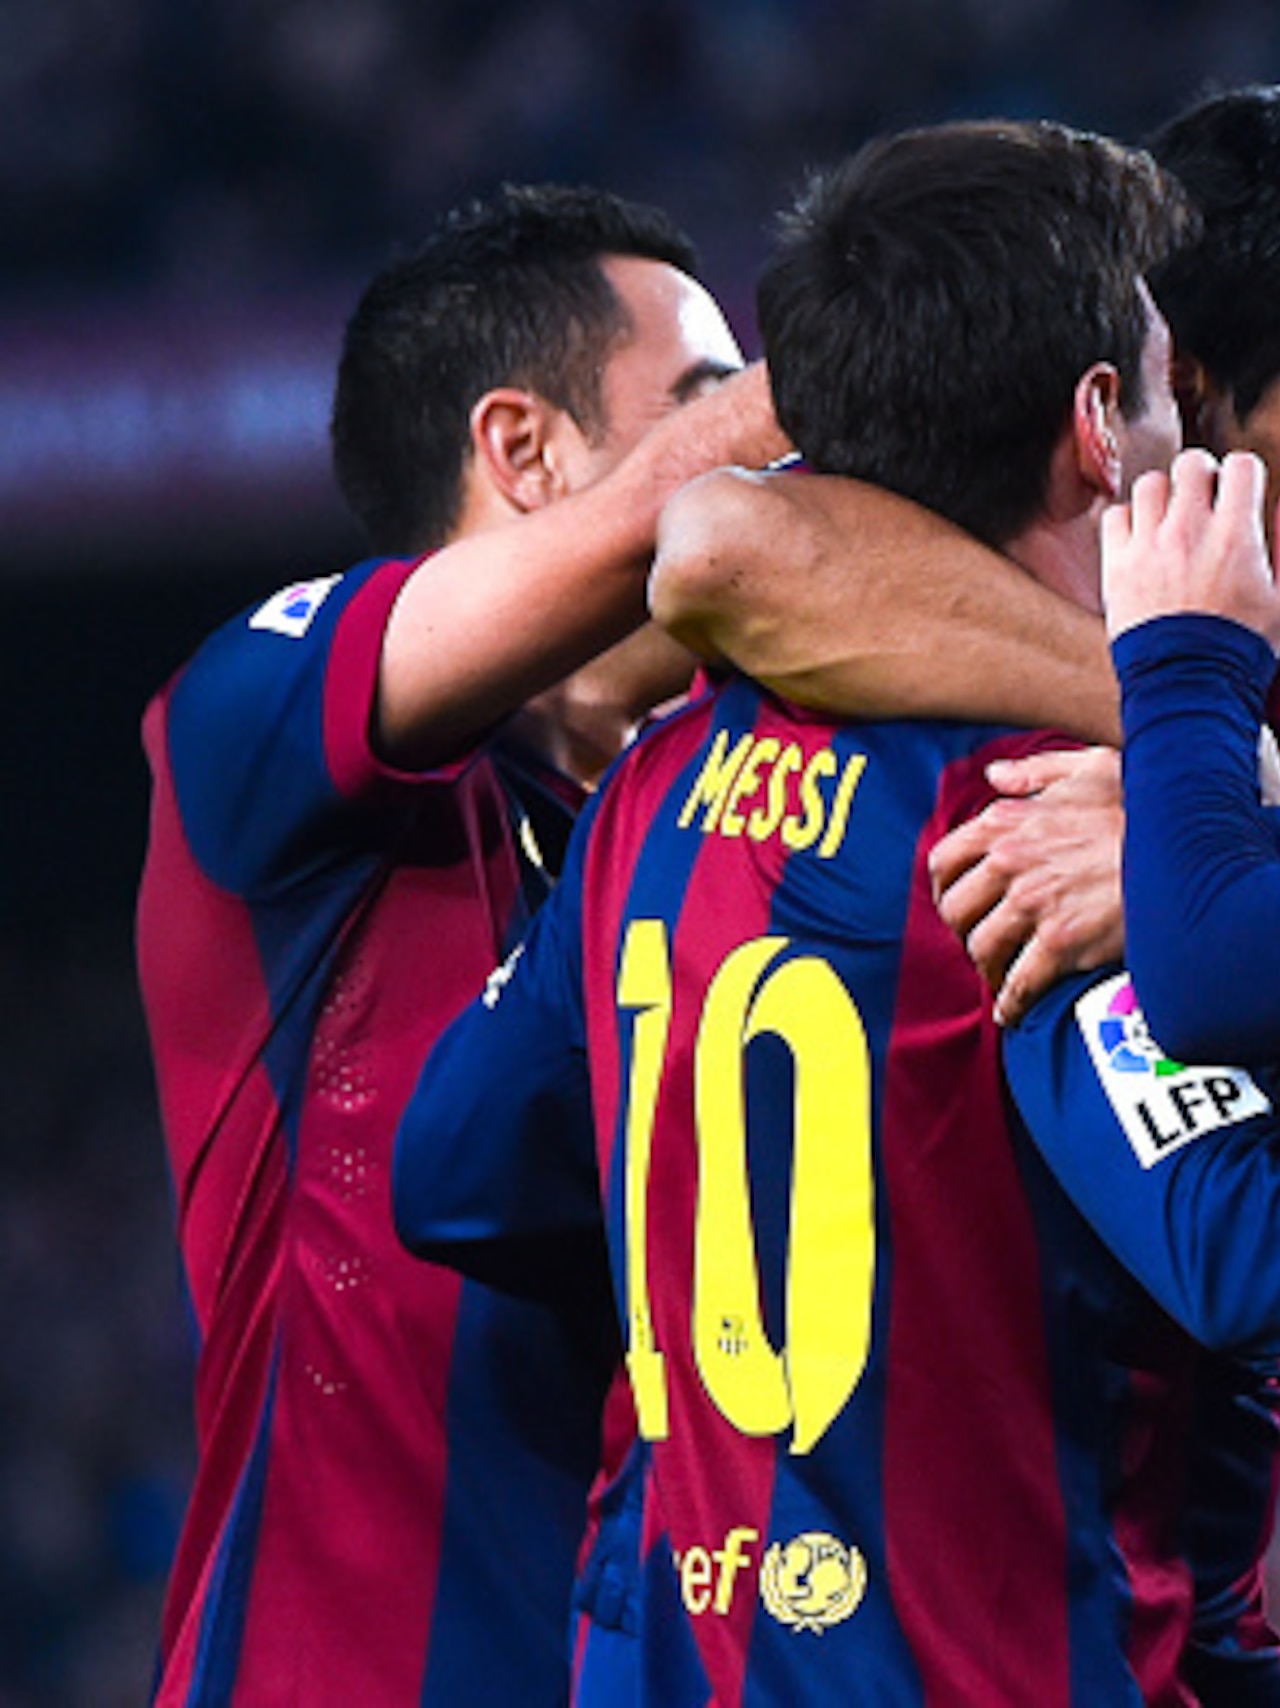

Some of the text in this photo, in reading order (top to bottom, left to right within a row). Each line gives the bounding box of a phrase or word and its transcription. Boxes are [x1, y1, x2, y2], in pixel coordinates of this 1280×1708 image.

[677, 728, 867, 858] MESSI
[1136, 1077, 1241, 1150] LFP
[617, 919, 875, 1454] 10
[673, 1526, 759, 1615] ef
